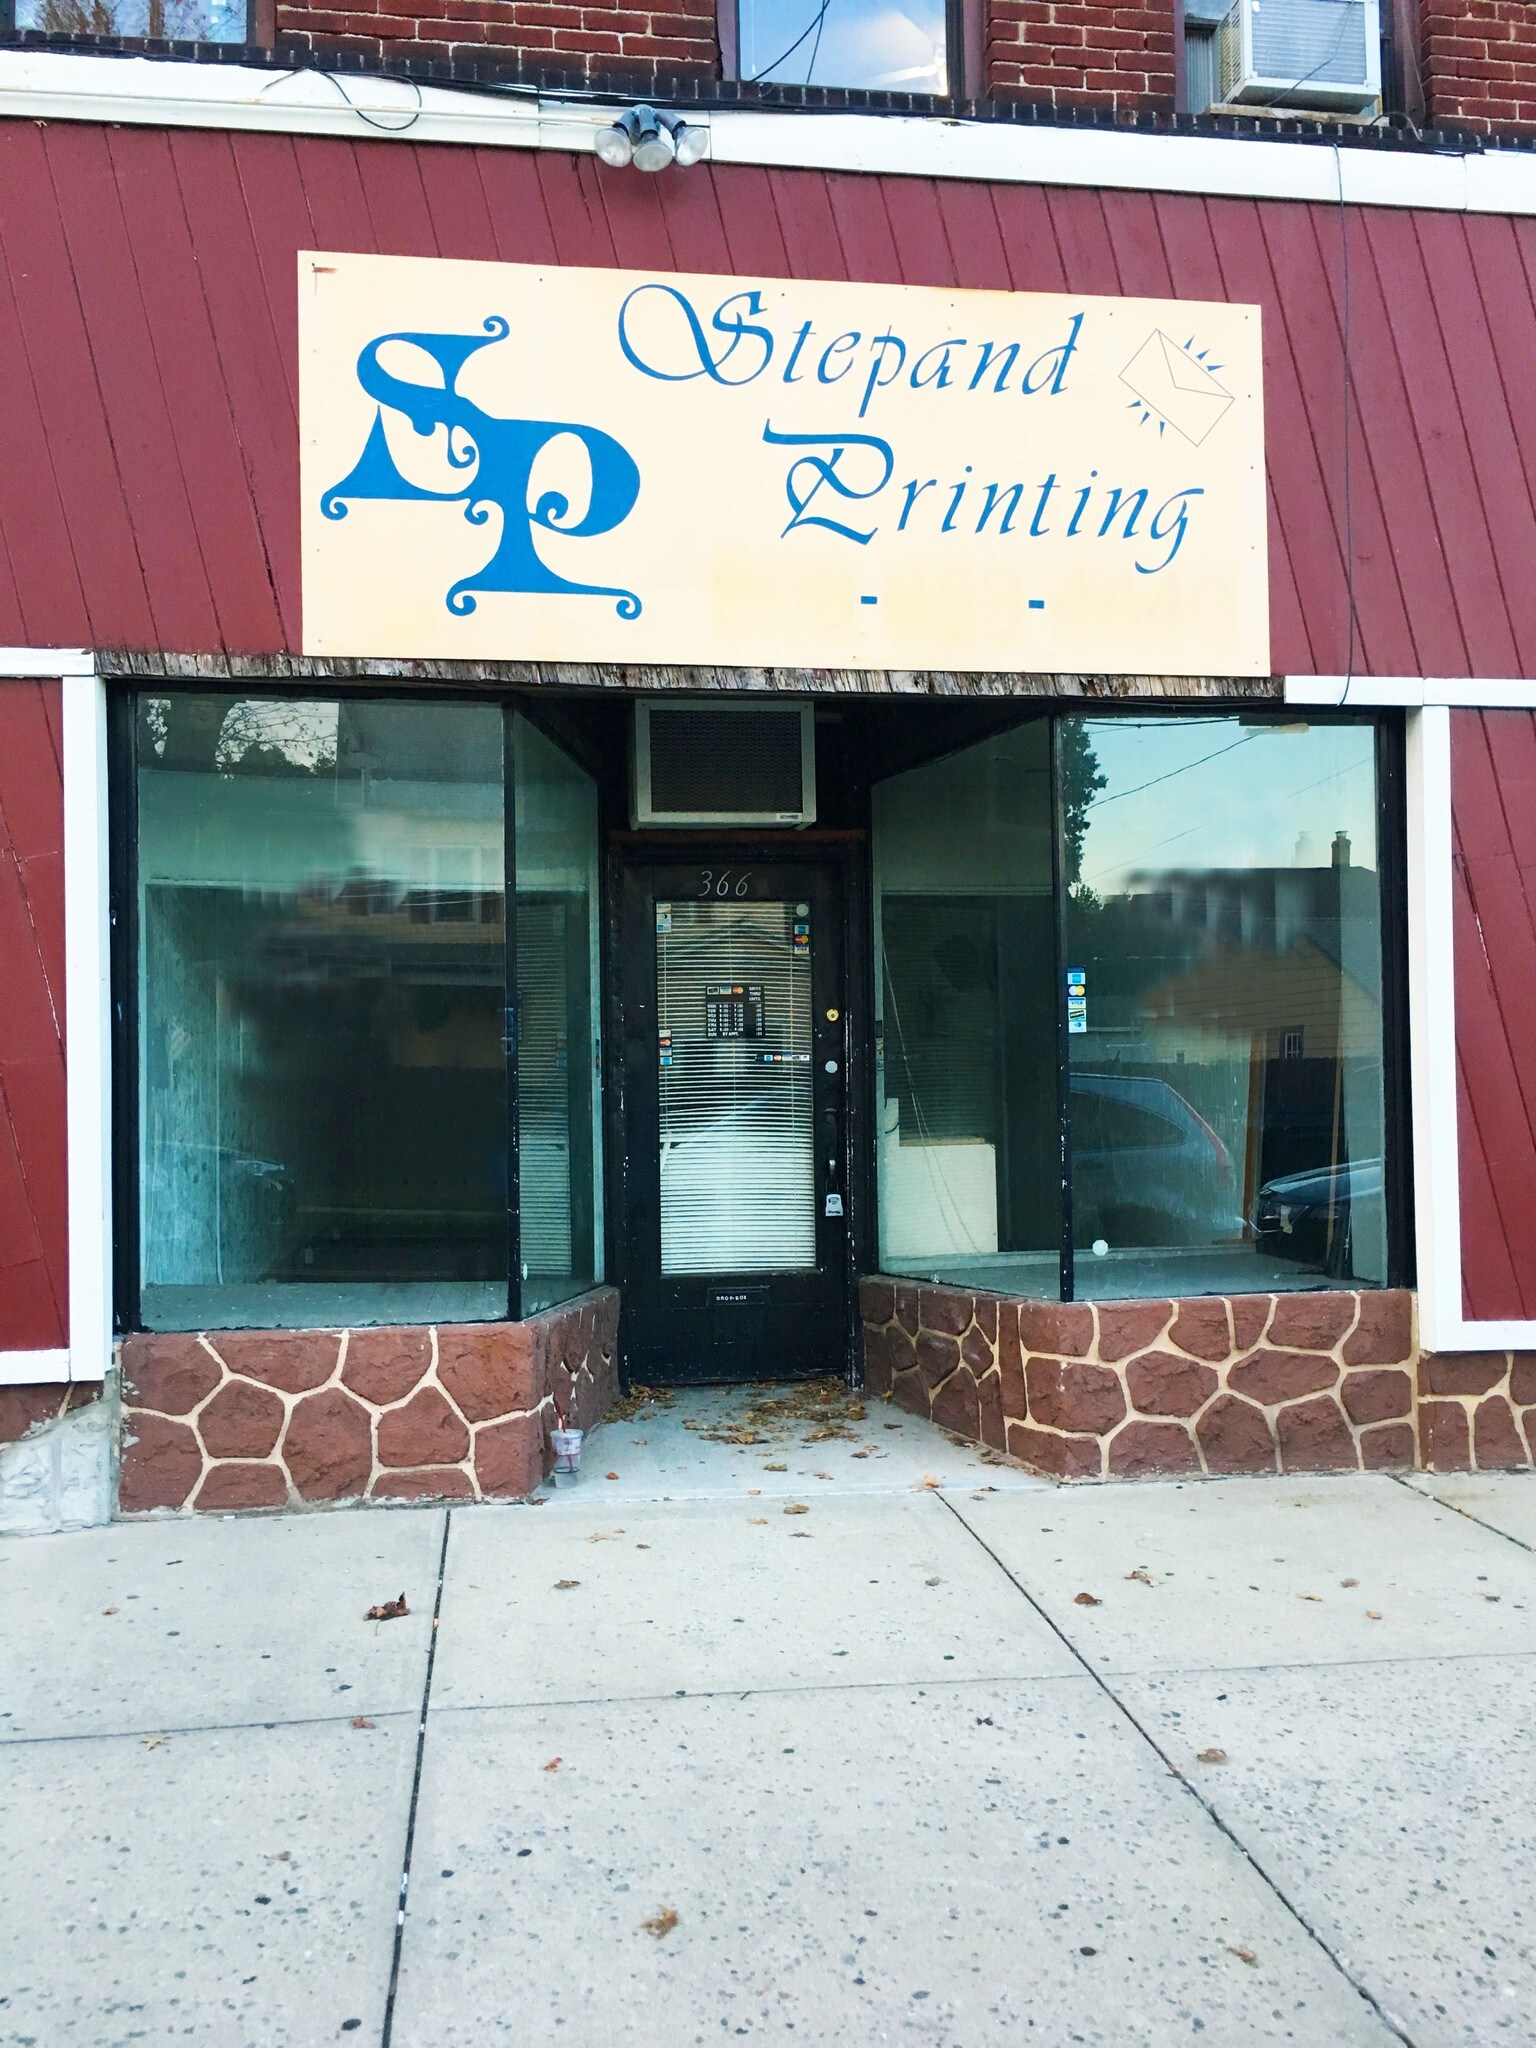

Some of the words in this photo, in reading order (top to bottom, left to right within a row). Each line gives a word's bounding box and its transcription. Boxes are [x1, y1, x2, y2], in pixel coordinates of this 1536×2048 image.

[618, 284, 1085, 419] Stepand
[761, 418, 1205, 575] Printing
[698, 870, 752, 897] 366
